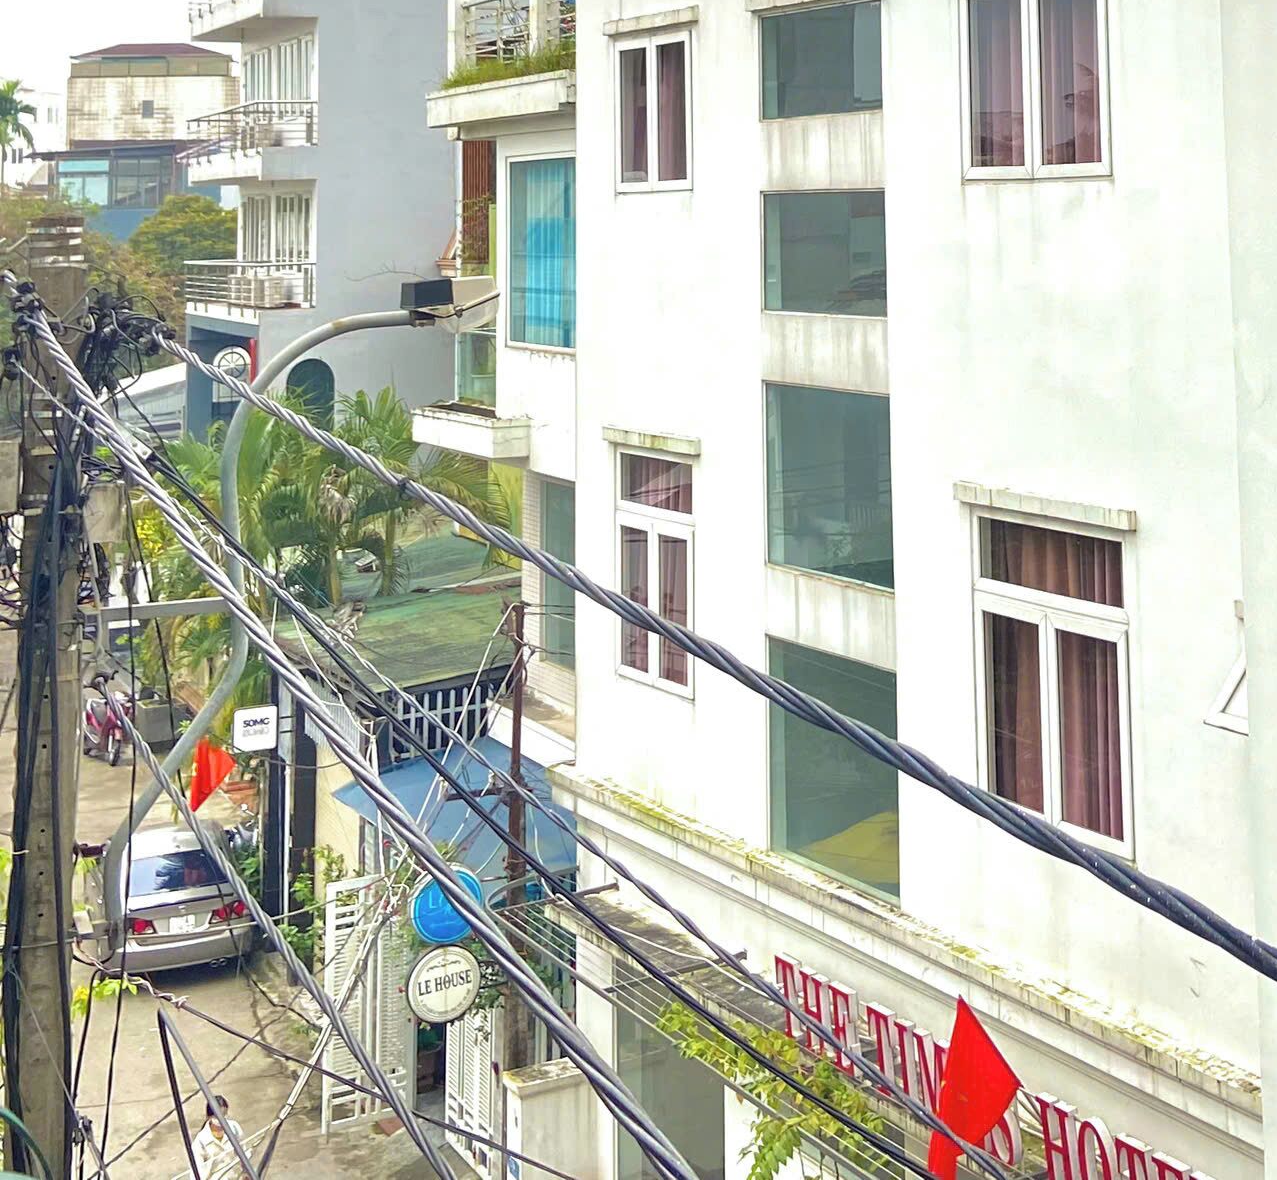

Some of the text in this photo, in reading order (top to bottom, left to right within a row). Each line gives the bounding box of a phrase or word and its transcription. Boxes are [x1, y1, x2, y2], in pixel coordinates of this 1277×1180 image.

[418, 969, 472, 996] LE HOUSE
[775, 954, 862, 1078] THE
